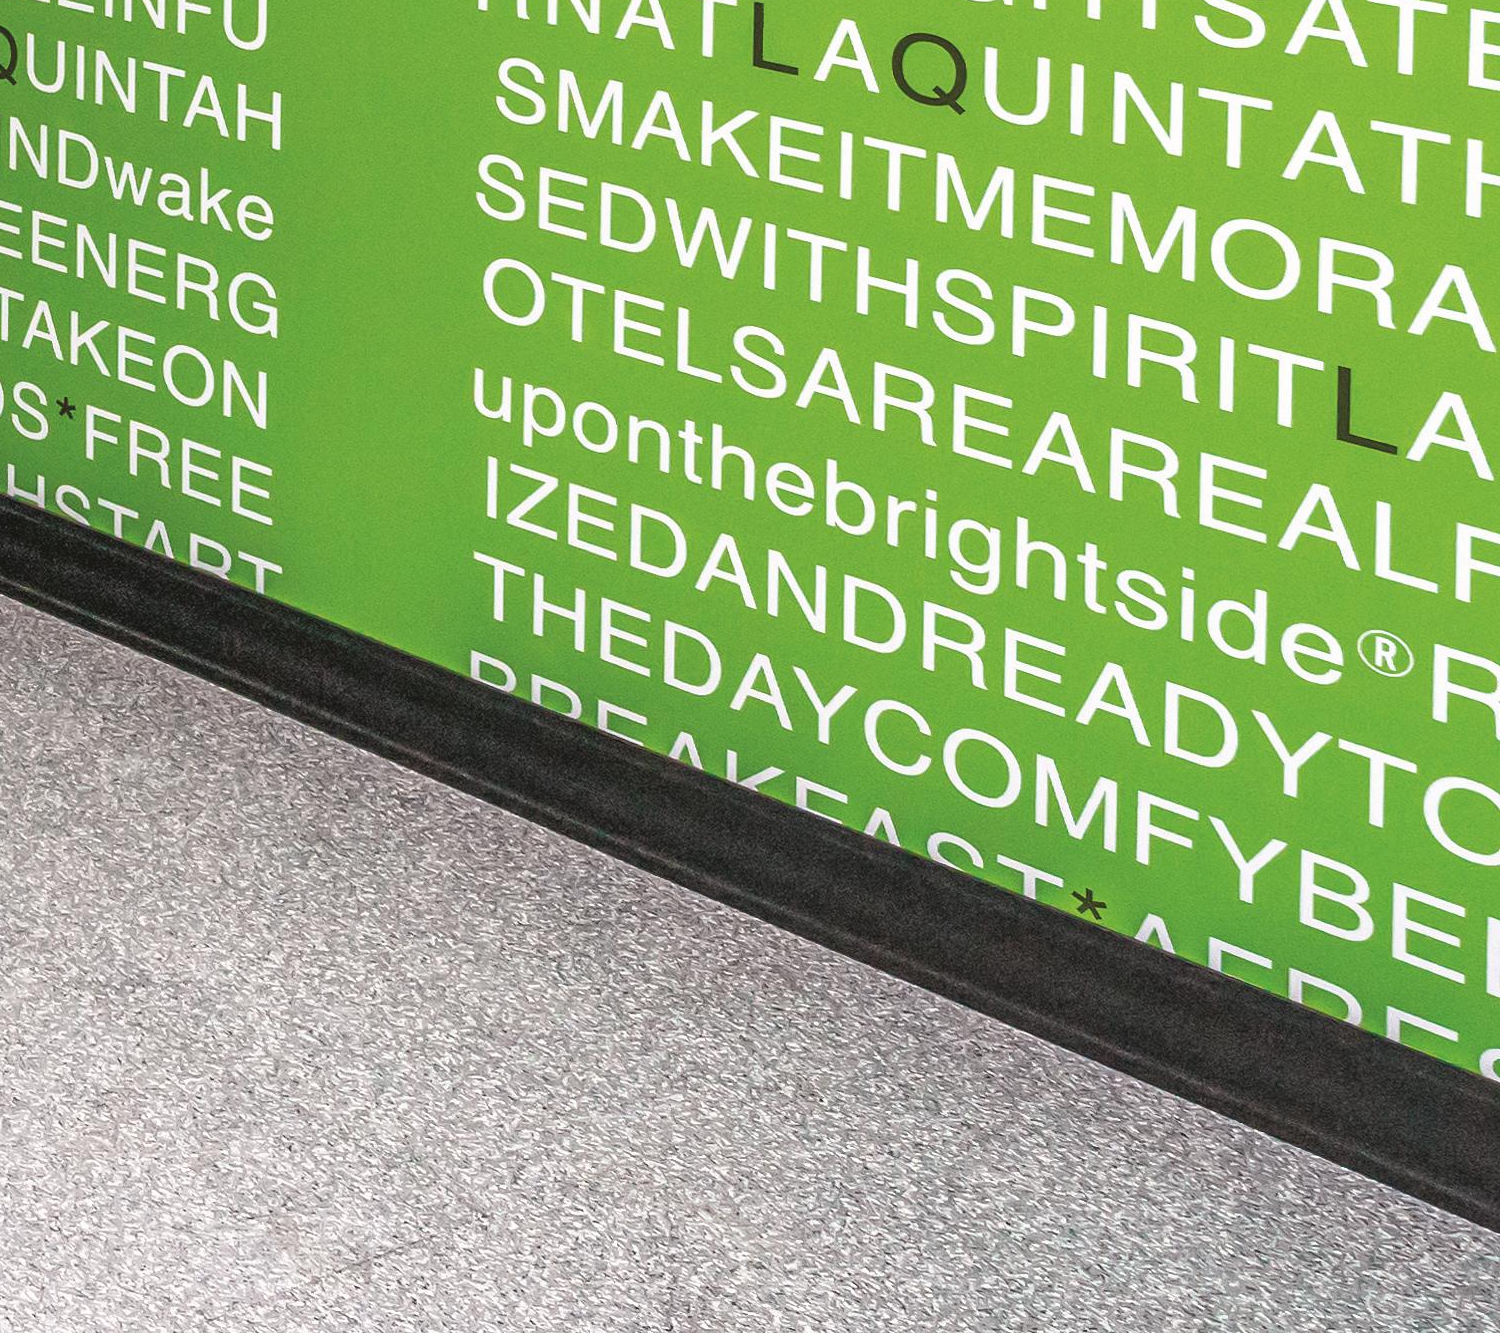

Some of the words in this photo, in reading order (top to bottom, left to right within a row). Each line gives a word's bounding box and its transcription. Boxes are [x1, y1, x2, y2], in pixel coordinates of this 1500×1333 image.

[476, 154, 1494, 481] SEDWITHSPIRITLA
[496, 58, 1496, 352] SMAKEITMEMORA
[474, 551, 1500, 998] THEDAYCOMFYBE
